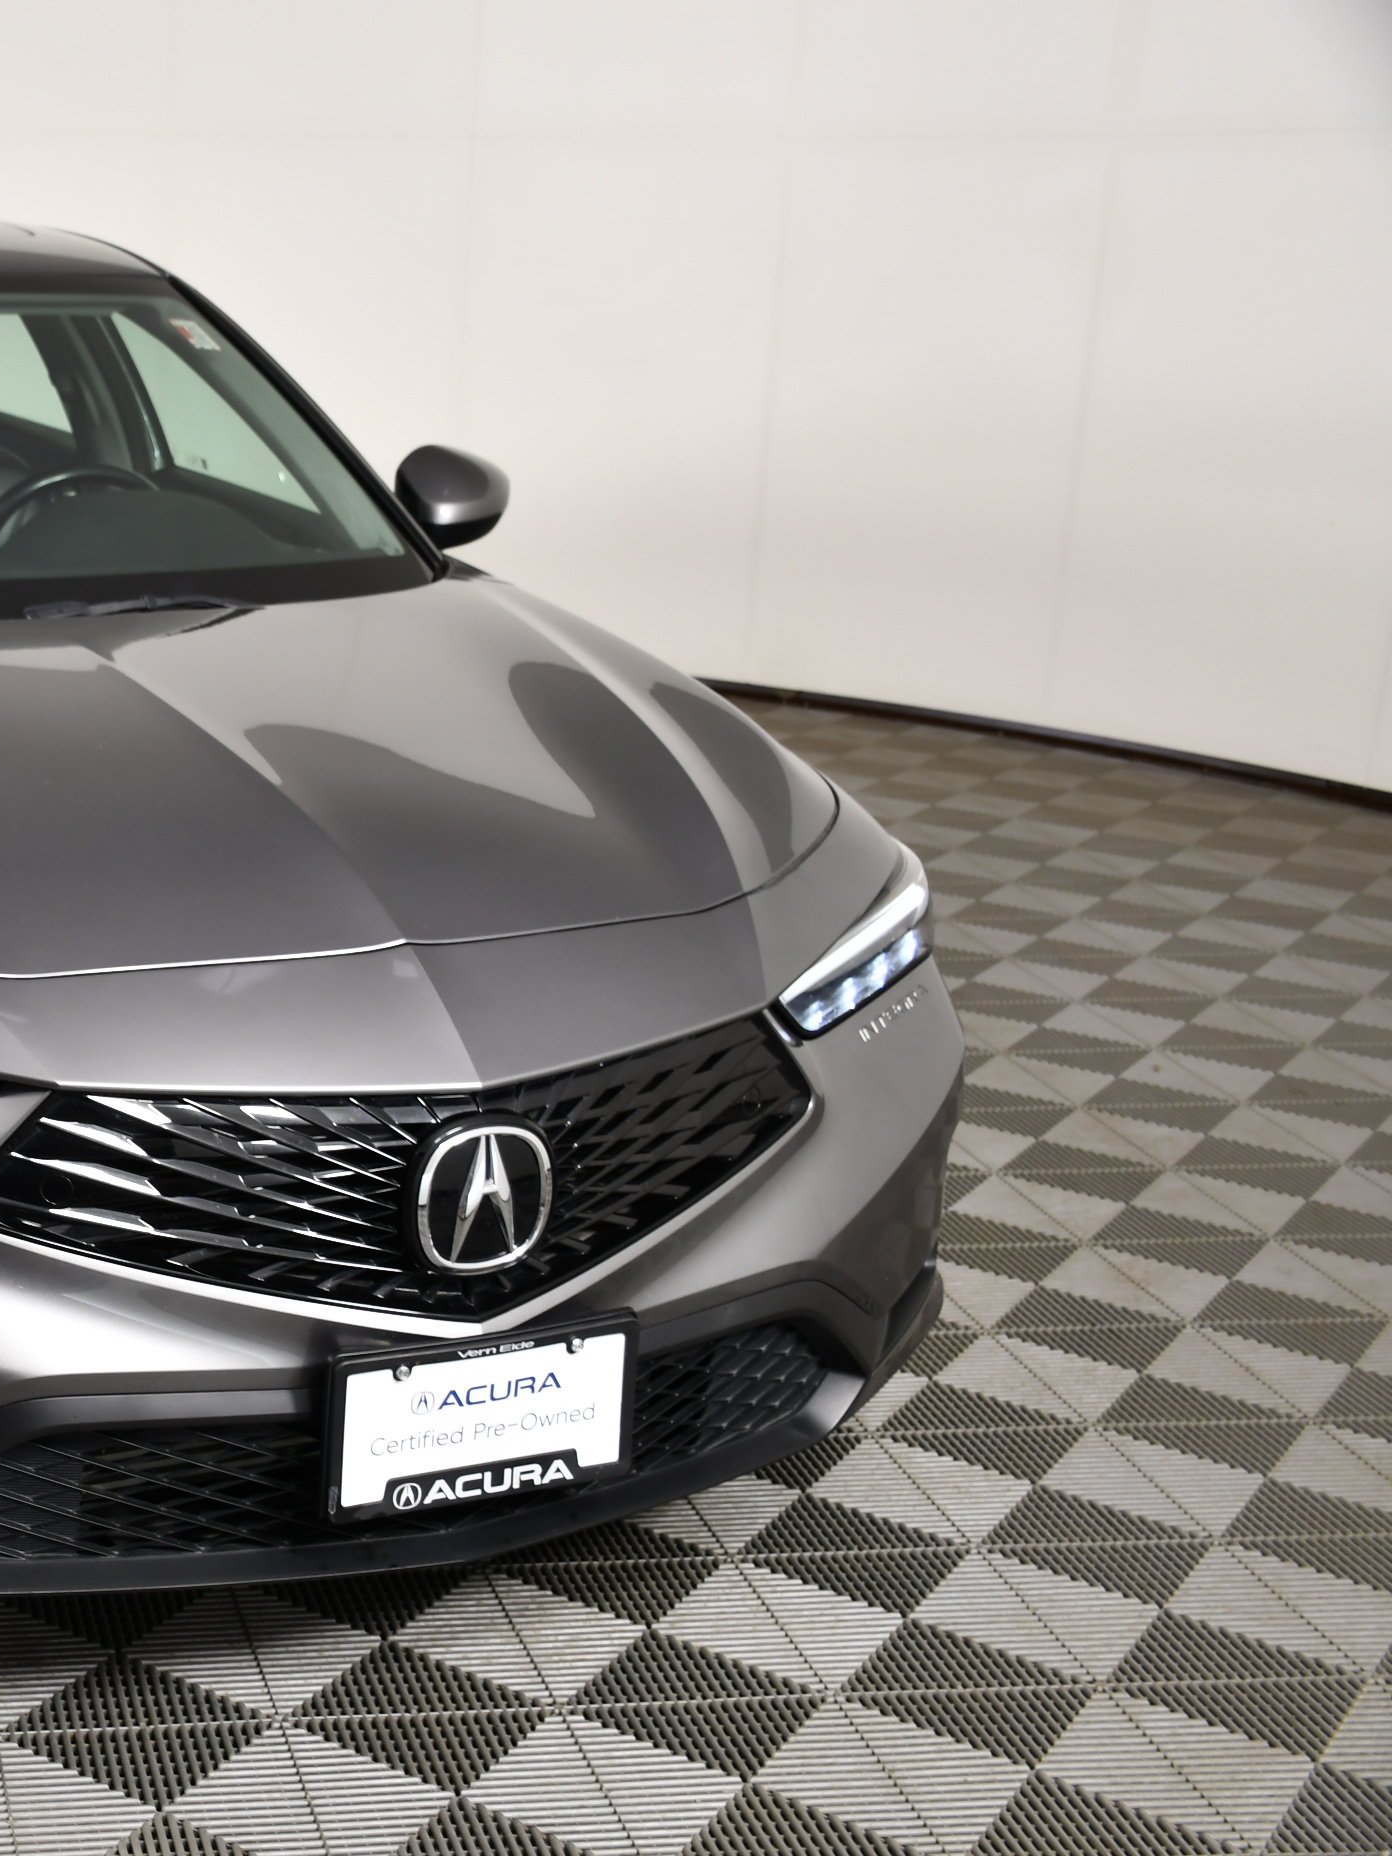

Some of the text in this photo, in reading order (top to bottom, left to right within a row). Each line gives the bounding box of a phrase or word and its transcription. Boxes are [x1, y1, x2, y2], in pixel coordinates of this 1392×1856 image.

[457, 1340, 536, 1359] Vern Eide
[438, 1371, 562, 1410] ACURA
[370, 1402, 596, 1456] Certified Pre-Owned
[422, 1458, 575, 1505] ACURA
